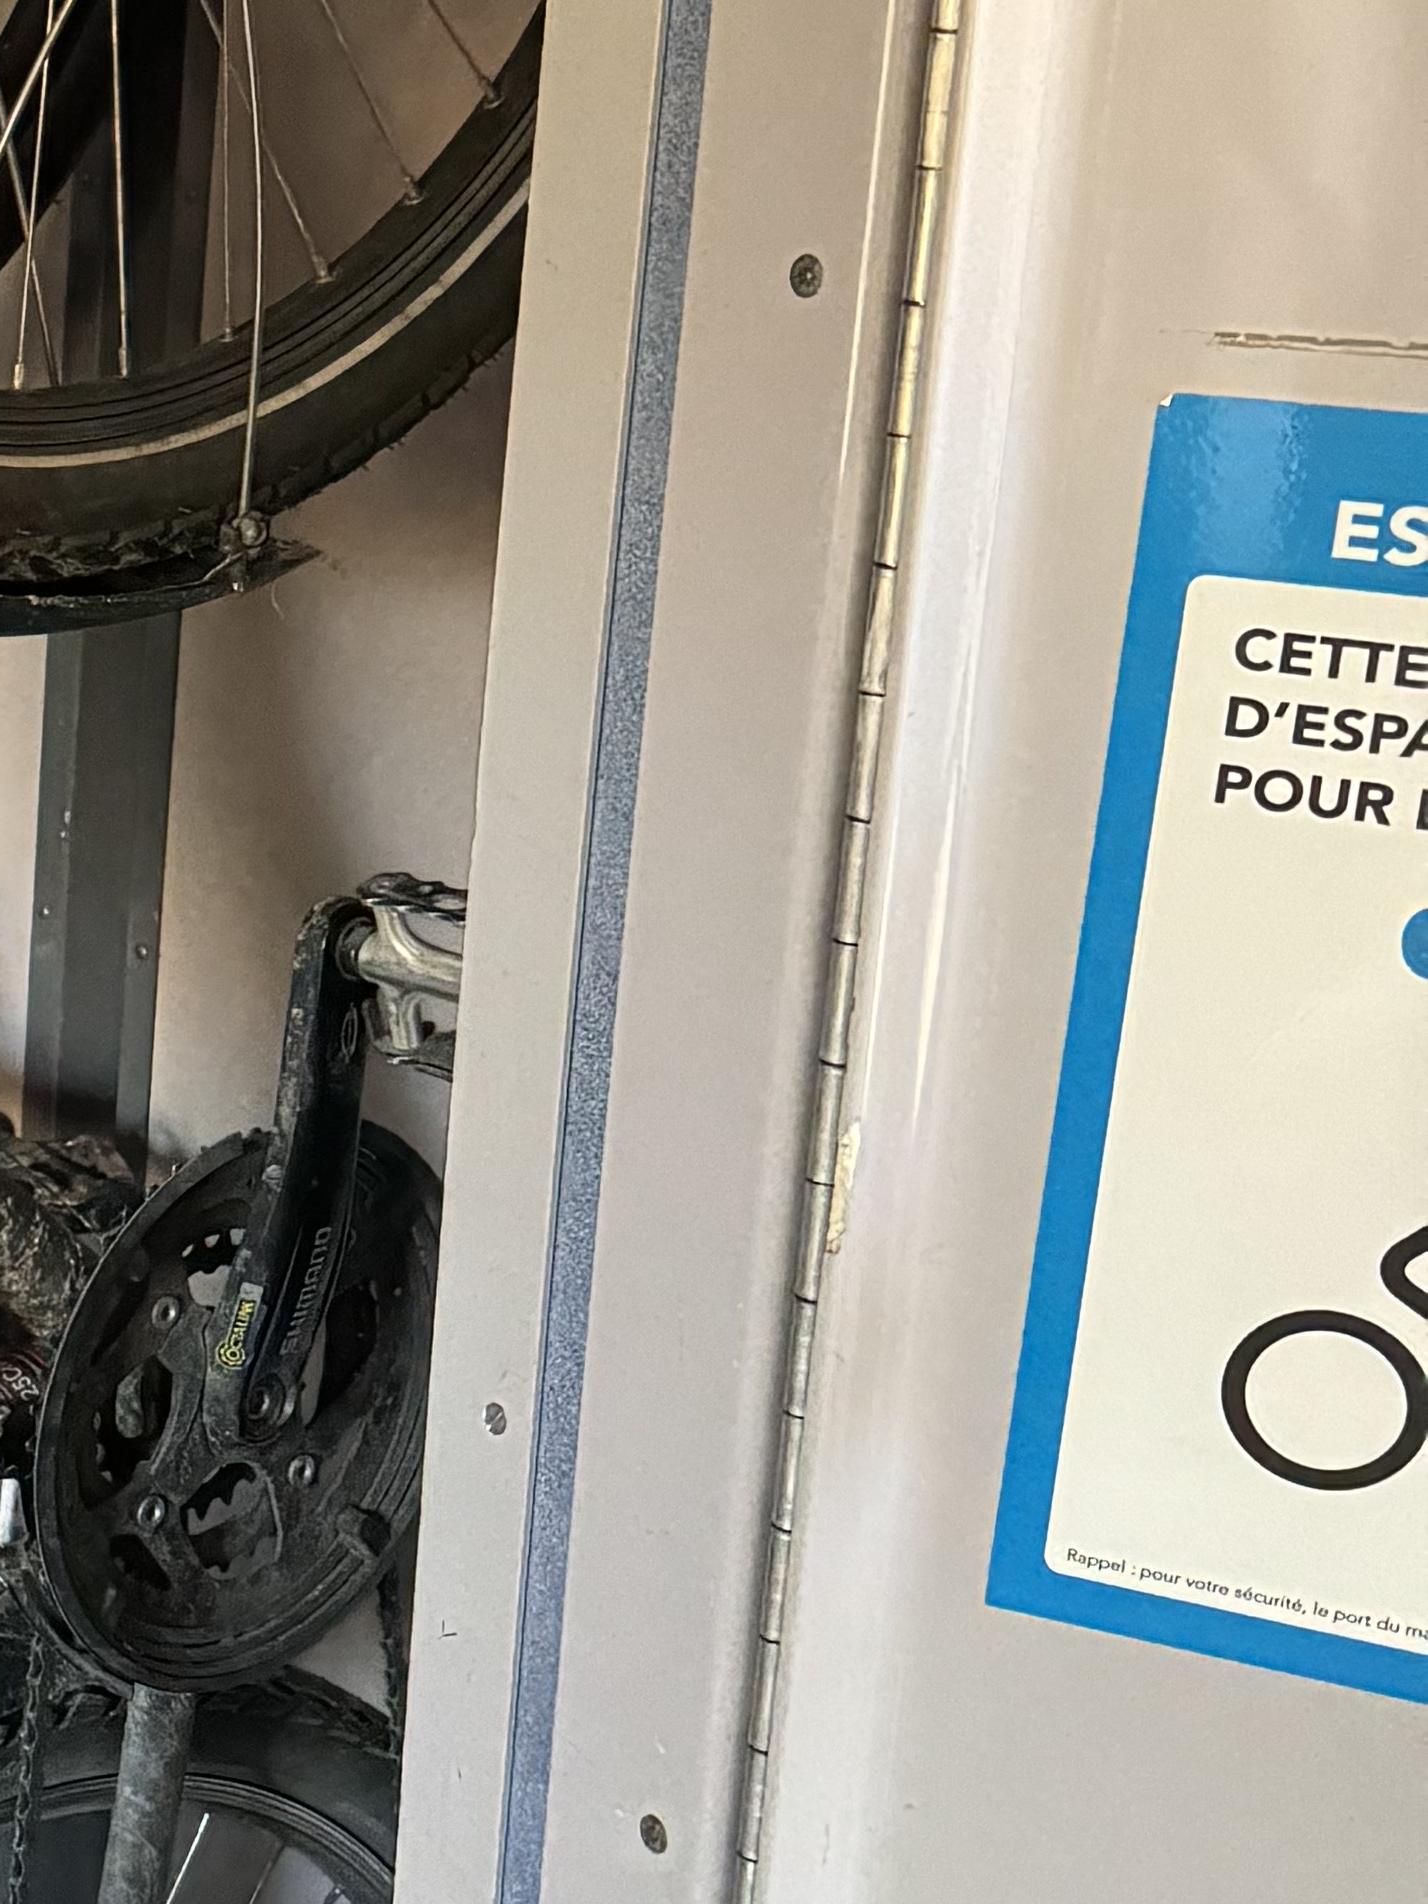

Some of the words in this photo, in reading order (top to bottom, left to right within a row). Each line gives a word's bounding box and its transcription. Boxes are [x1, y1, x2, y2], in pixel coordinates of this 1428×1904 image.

[1234, 628, 1428, 689] CETTE
[1214, 763, 1394, 826] POUR
[280, 1226, 332, 1356] SHIMANO
[1066, 1547, 1125, 1574] Rappel
[1139, 1565, 1181, 1586] pour
[1186, 1573, 1229, 1596] votre
[1234, 1587, 1306, 1615] sécurité,
[1313, 1601, 1328, 1617] le
[1332, 1610, 1371, 1623] port
[1376, 1617, 1400, 1633] du
